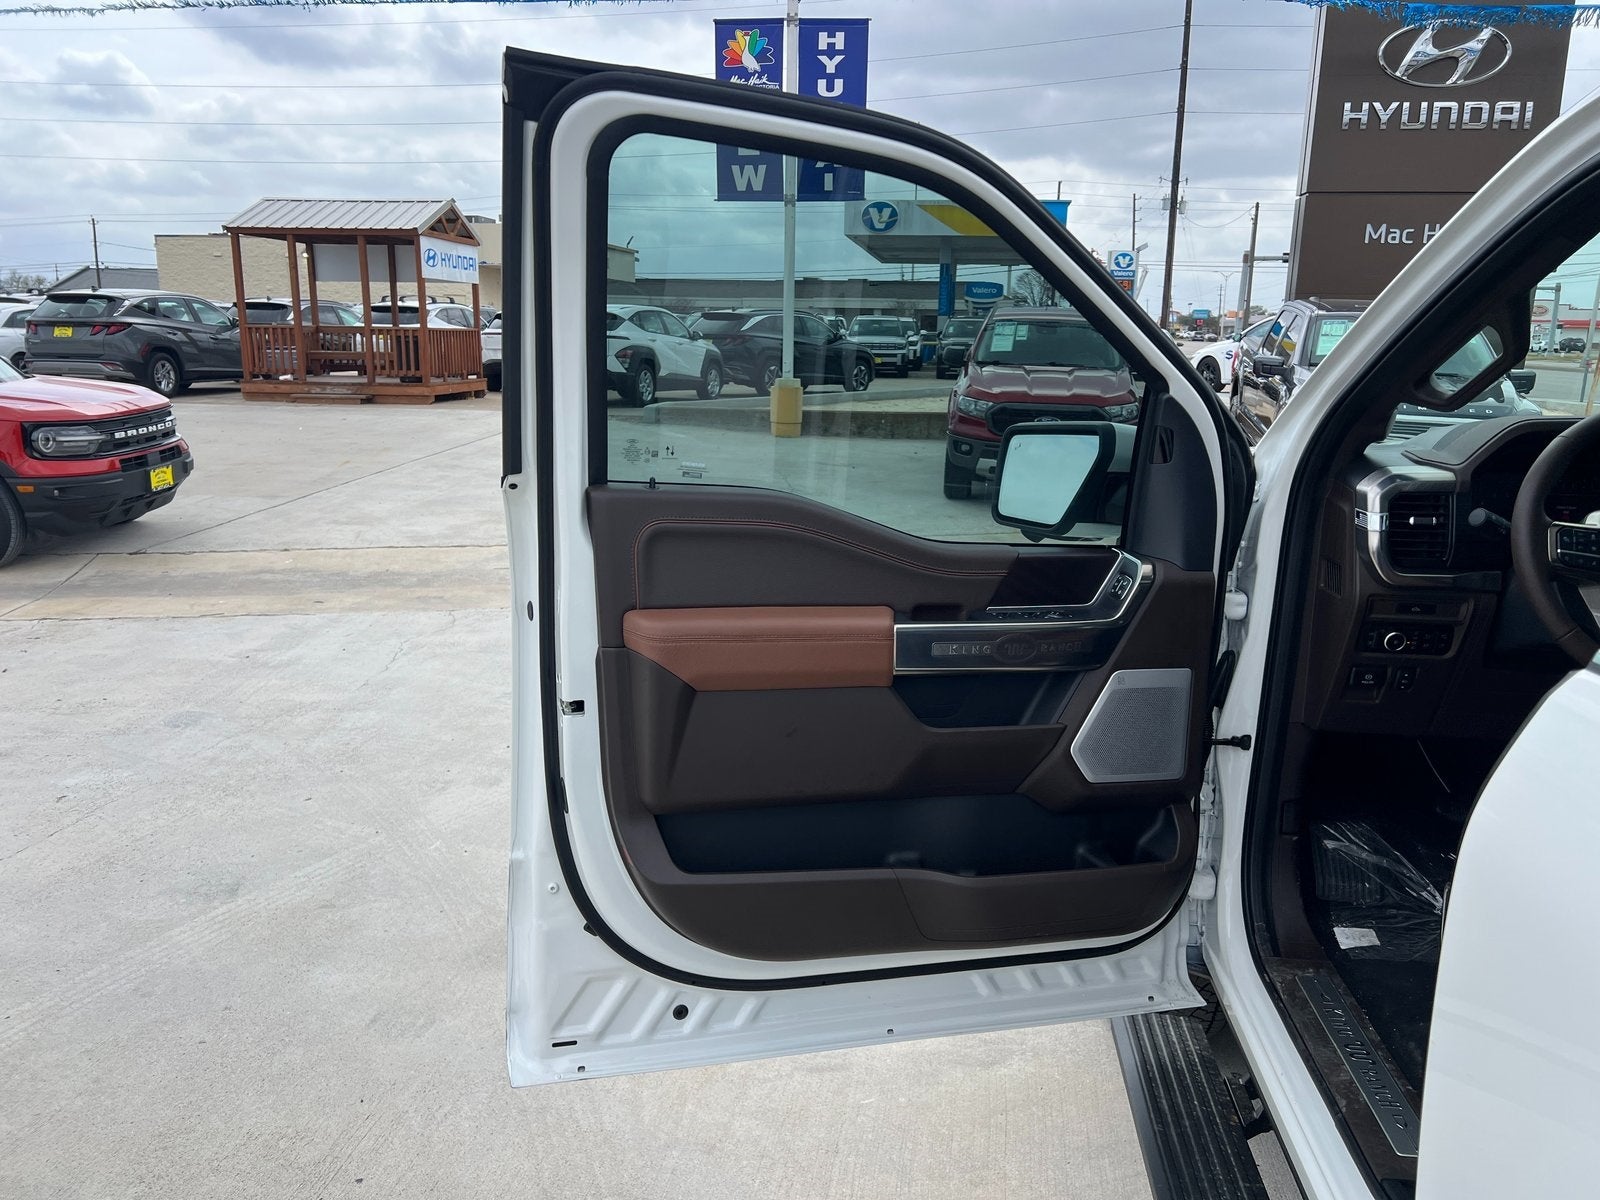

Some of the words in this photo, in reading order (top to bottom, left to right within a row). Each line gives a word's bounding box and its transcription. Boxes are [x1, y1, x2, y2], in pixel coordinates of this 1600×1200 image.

[730, 75, 748, 85] Mac
[747, 73, 779, 87] Haik
[1341, 101, 1534, 130] HYUNDAI
[1364, 223, 1413, 244] Mac
[440, 252, 477, 271] HYUNDAI
[114, 420, 172, 439] BRONCO
[949, 644, 991, 655] KING
[1040, 641, 1082, 653] RANCH
